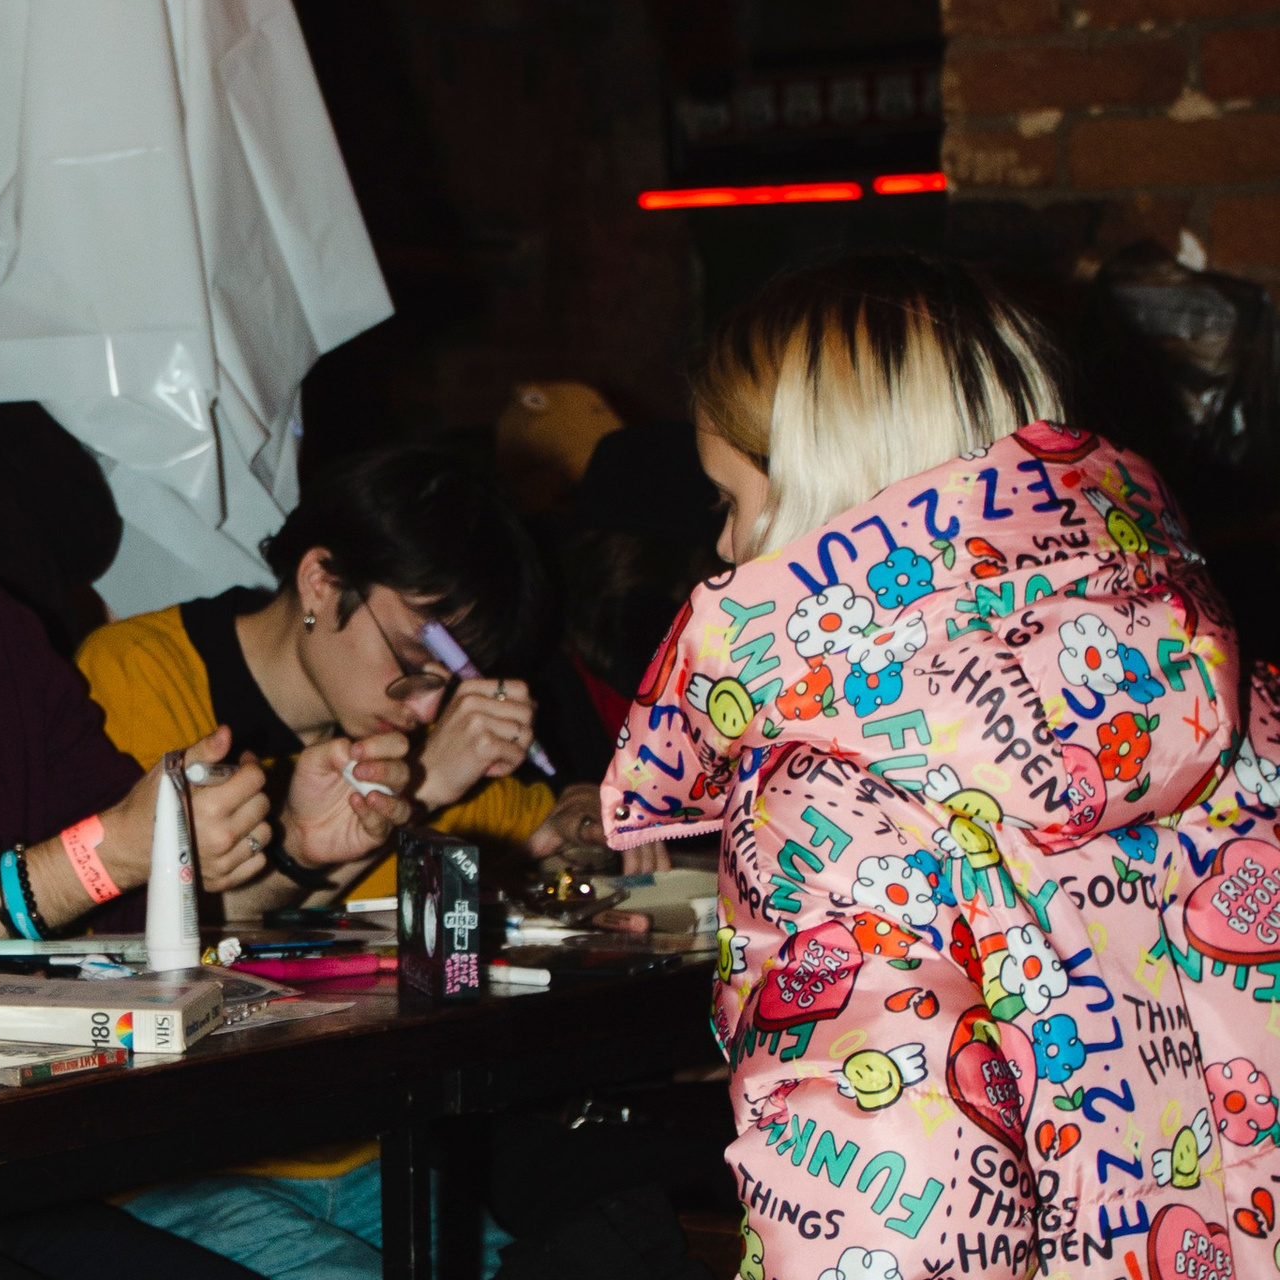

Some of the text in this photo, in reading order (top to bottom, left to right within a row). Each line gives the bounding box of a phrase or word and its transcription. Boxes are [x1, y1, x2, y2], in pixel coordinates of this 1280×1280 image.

[451, 849, 478, 880] MCR
[1212, 856, 1265, 918] FRIES
[157, 1016, 170, 1046] VHS
[738, 1162, 846, 1240] THINGS
[971, 1145, 1060, 1204] GOOD
[957, 1225, 1114, 1277] HAPPEN
